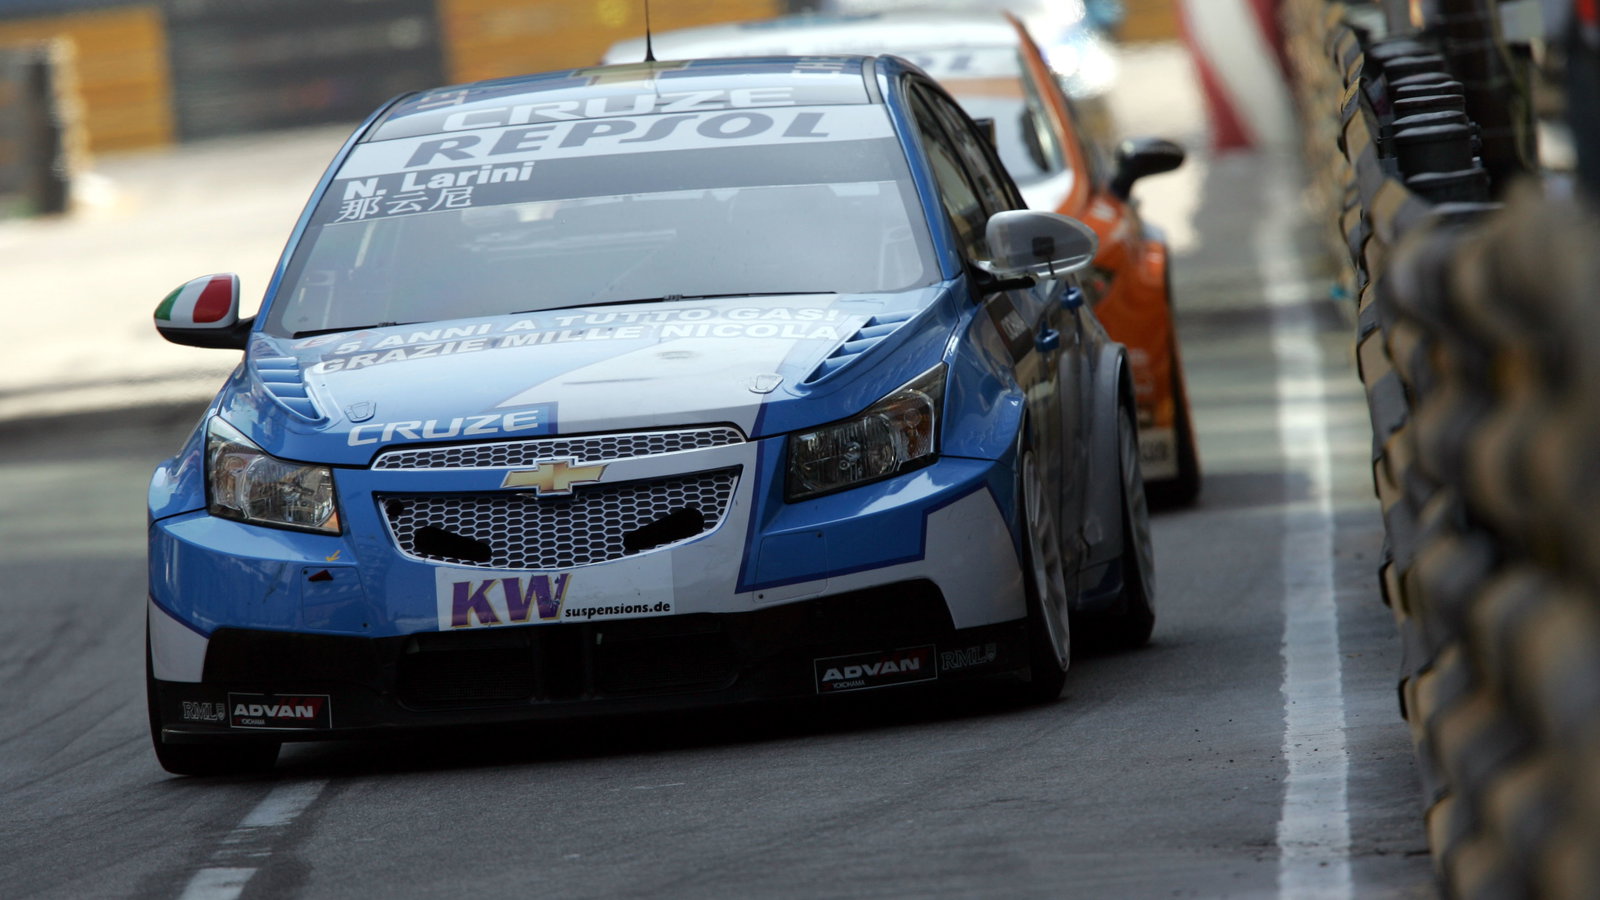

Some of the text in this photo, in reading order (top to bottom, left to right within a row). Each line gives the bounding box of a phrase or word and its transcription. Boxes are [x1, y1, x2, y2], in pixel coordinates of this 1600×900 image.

[445, 87, 795, 129] CRUZE
[405, 112, 829, 167] REPSOL
[342, 161, 536, 201] N. Larini
[334, 185, 473, 223] 那云尼
[318, 338, 487, 372] GRAZIE
[500, 326, 644, 348] MILLE
[660, 323, 839, 340] NICOLA
[334, 341, 362, 355] 5
[372, 323, 492, 349] ANNI
[504, 319, 536, 332] A
[555, 308, 711, 327] TUTTO
[727, 307, 840, 321] GAS!
[347, 409, 539, 447] CRUZE
[450, 572, 572, 627] KW
[565, 601, 671, 619] suspensions.de
[822, 658, 920, 681] ADVAN
[234, 704, 314, 718] ADVAN
